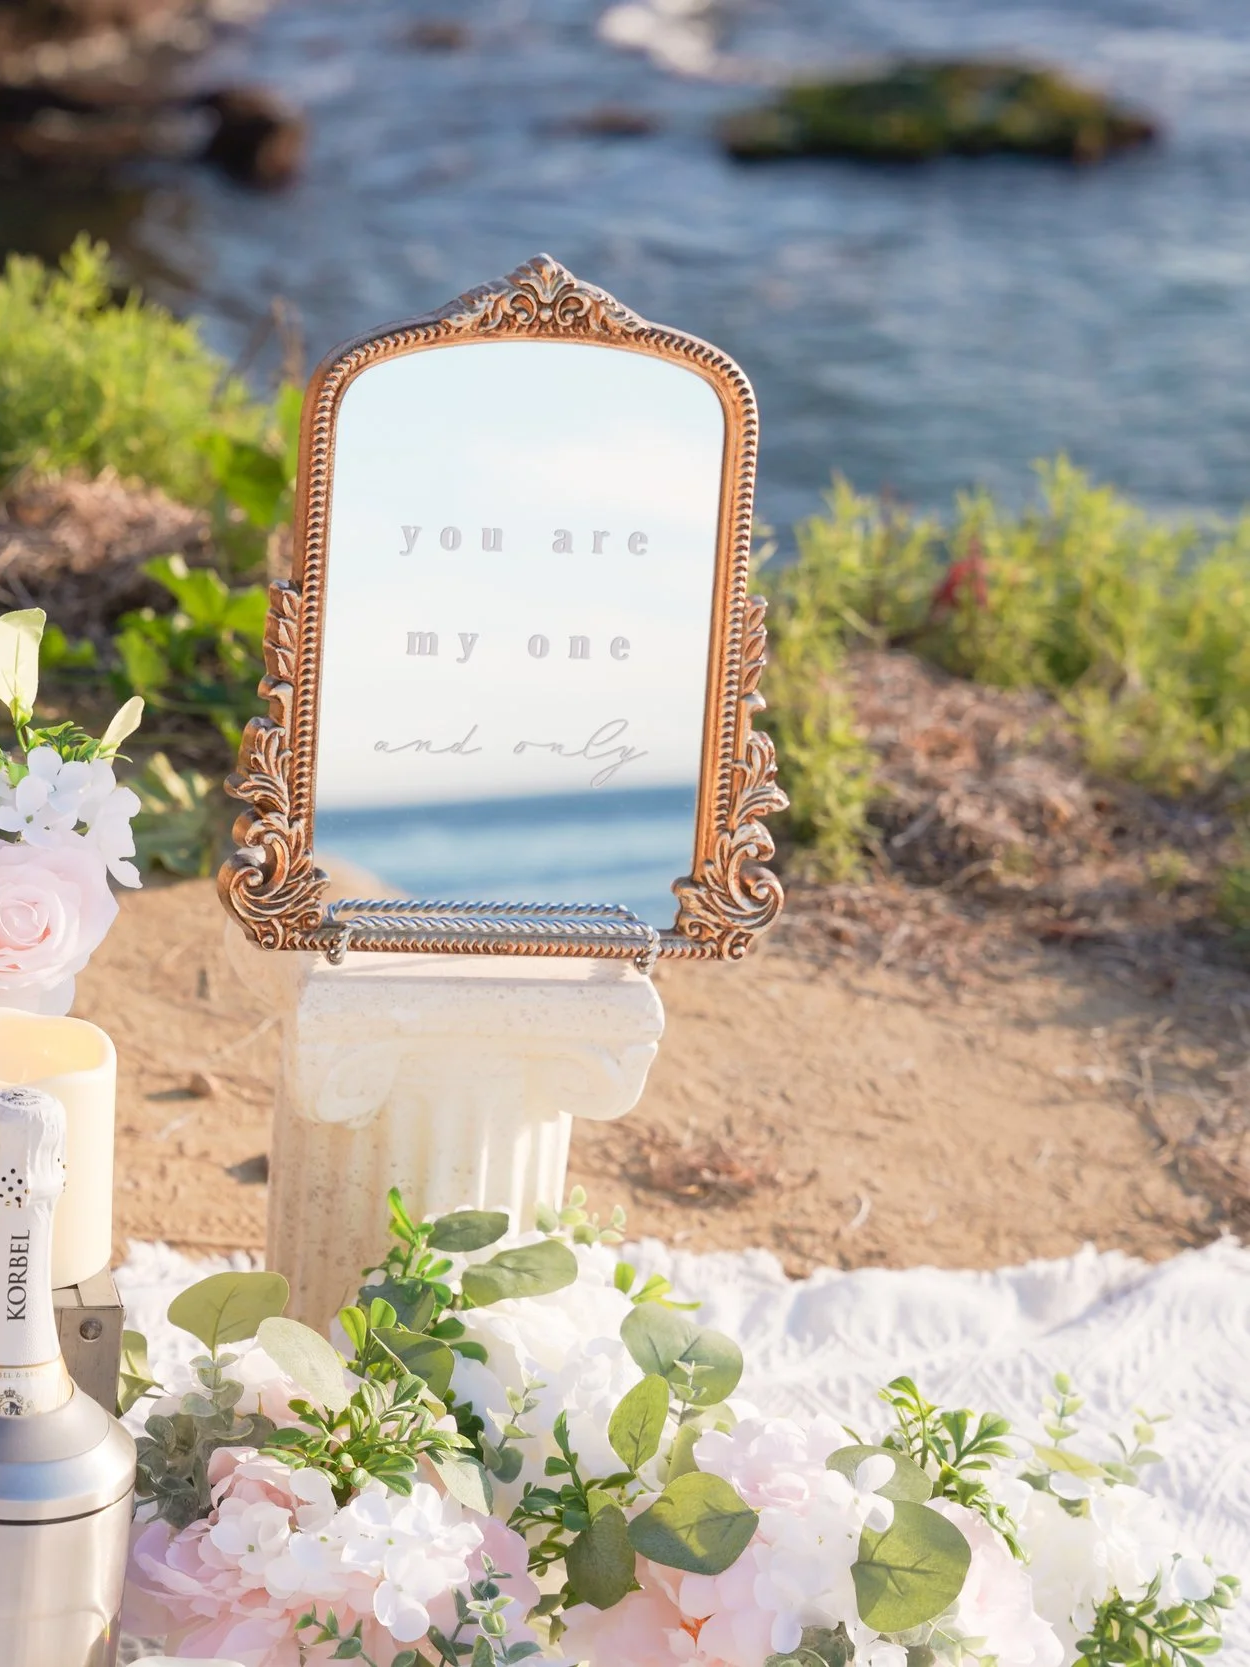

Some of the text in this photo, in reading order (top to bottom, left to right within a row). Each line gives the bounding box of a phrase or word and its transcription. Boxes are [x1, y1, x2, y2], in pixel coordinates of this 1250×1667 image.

[399, 525, 649, 556] you are
[405, 631, 631, 663] my one
[374, 718, 648, 788] and only
[6, 1229, 31, 1321] KORBEL
